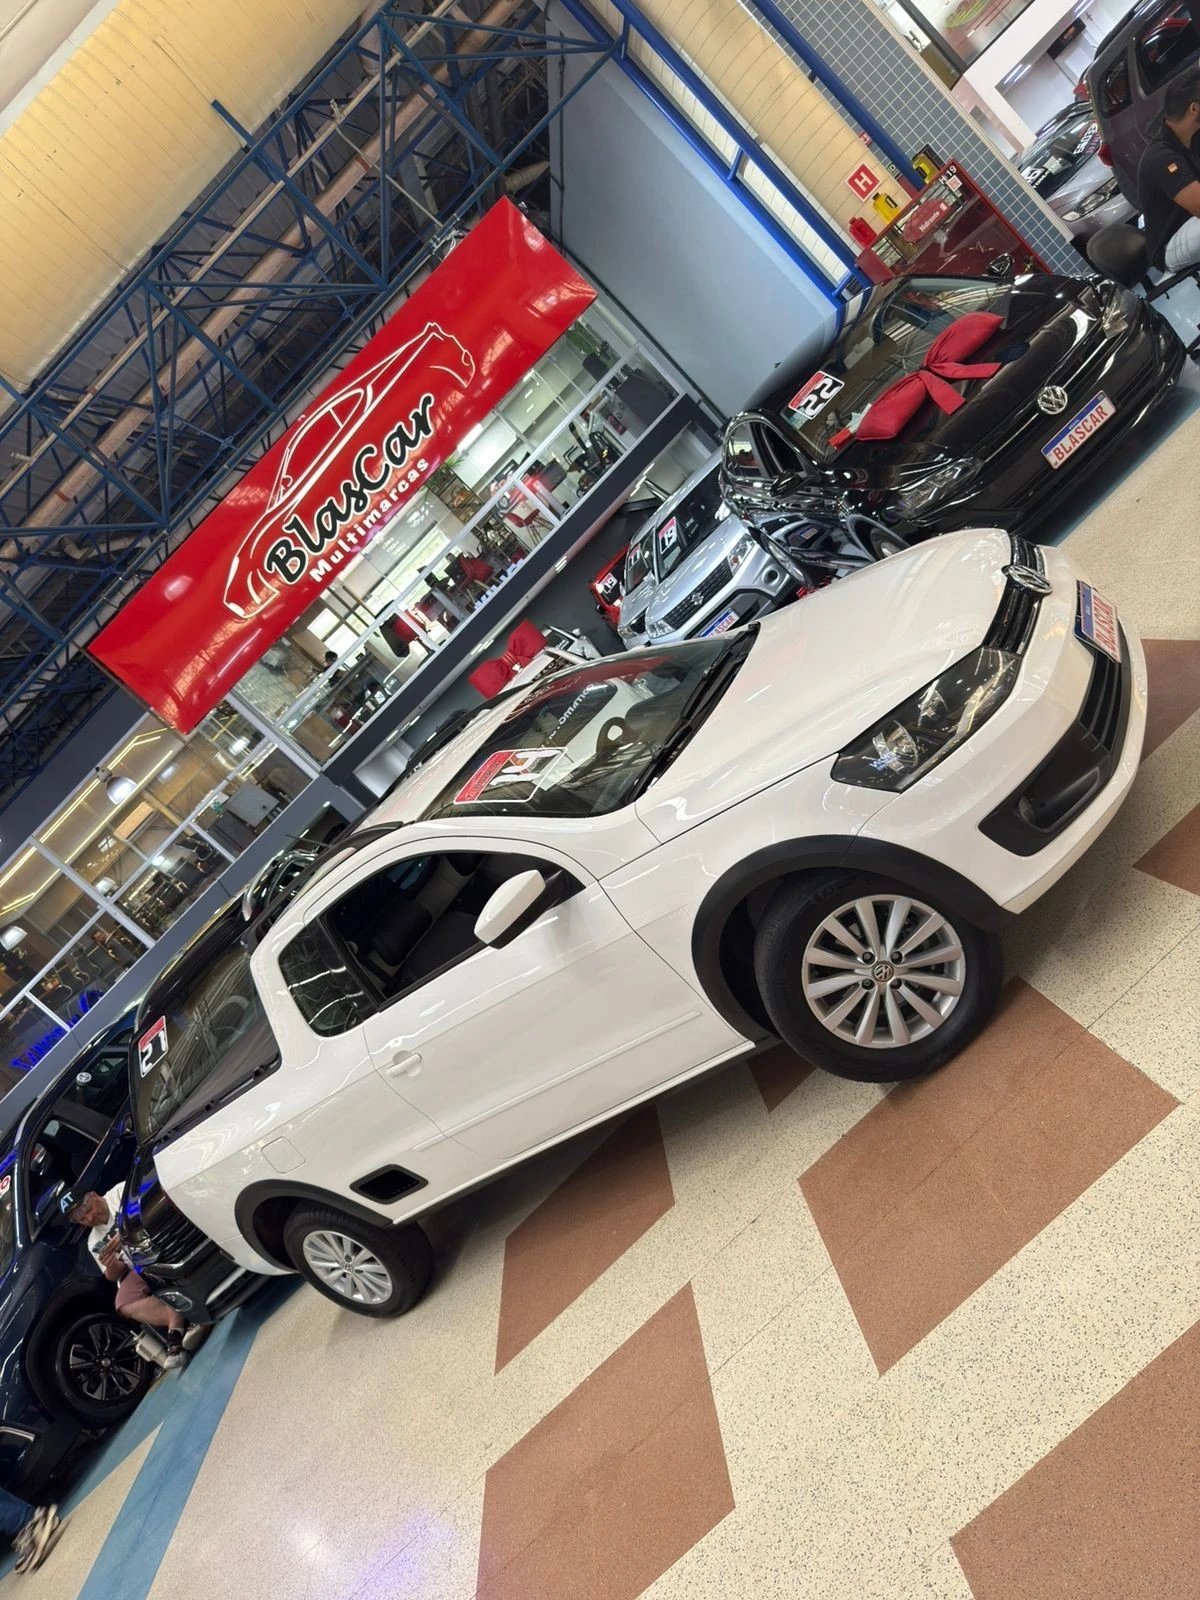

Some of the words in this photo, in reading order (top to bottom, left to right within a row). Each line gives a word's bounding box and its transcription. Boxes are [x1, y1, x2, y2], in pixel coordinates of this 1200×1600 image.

[854, 171, 873, 192] H
[939, 175, 947, 185] H
[946, 161, 957, 176] 19
[919, 211, 940, 232] Hidrante
[799, 377, 841, 416] 22
[1053, 405, 1108, 461] BLASCAR
[264, 394, 434, 585] BlasCar
[309, 458, 430, 583] Multimarcas
[1093, 595, 1117, 653] BLASCAR
[489, 750, 561, 786] 14
[141, 1030, 166, 1073] 21
[60, 1191, 74, 1214] AT
